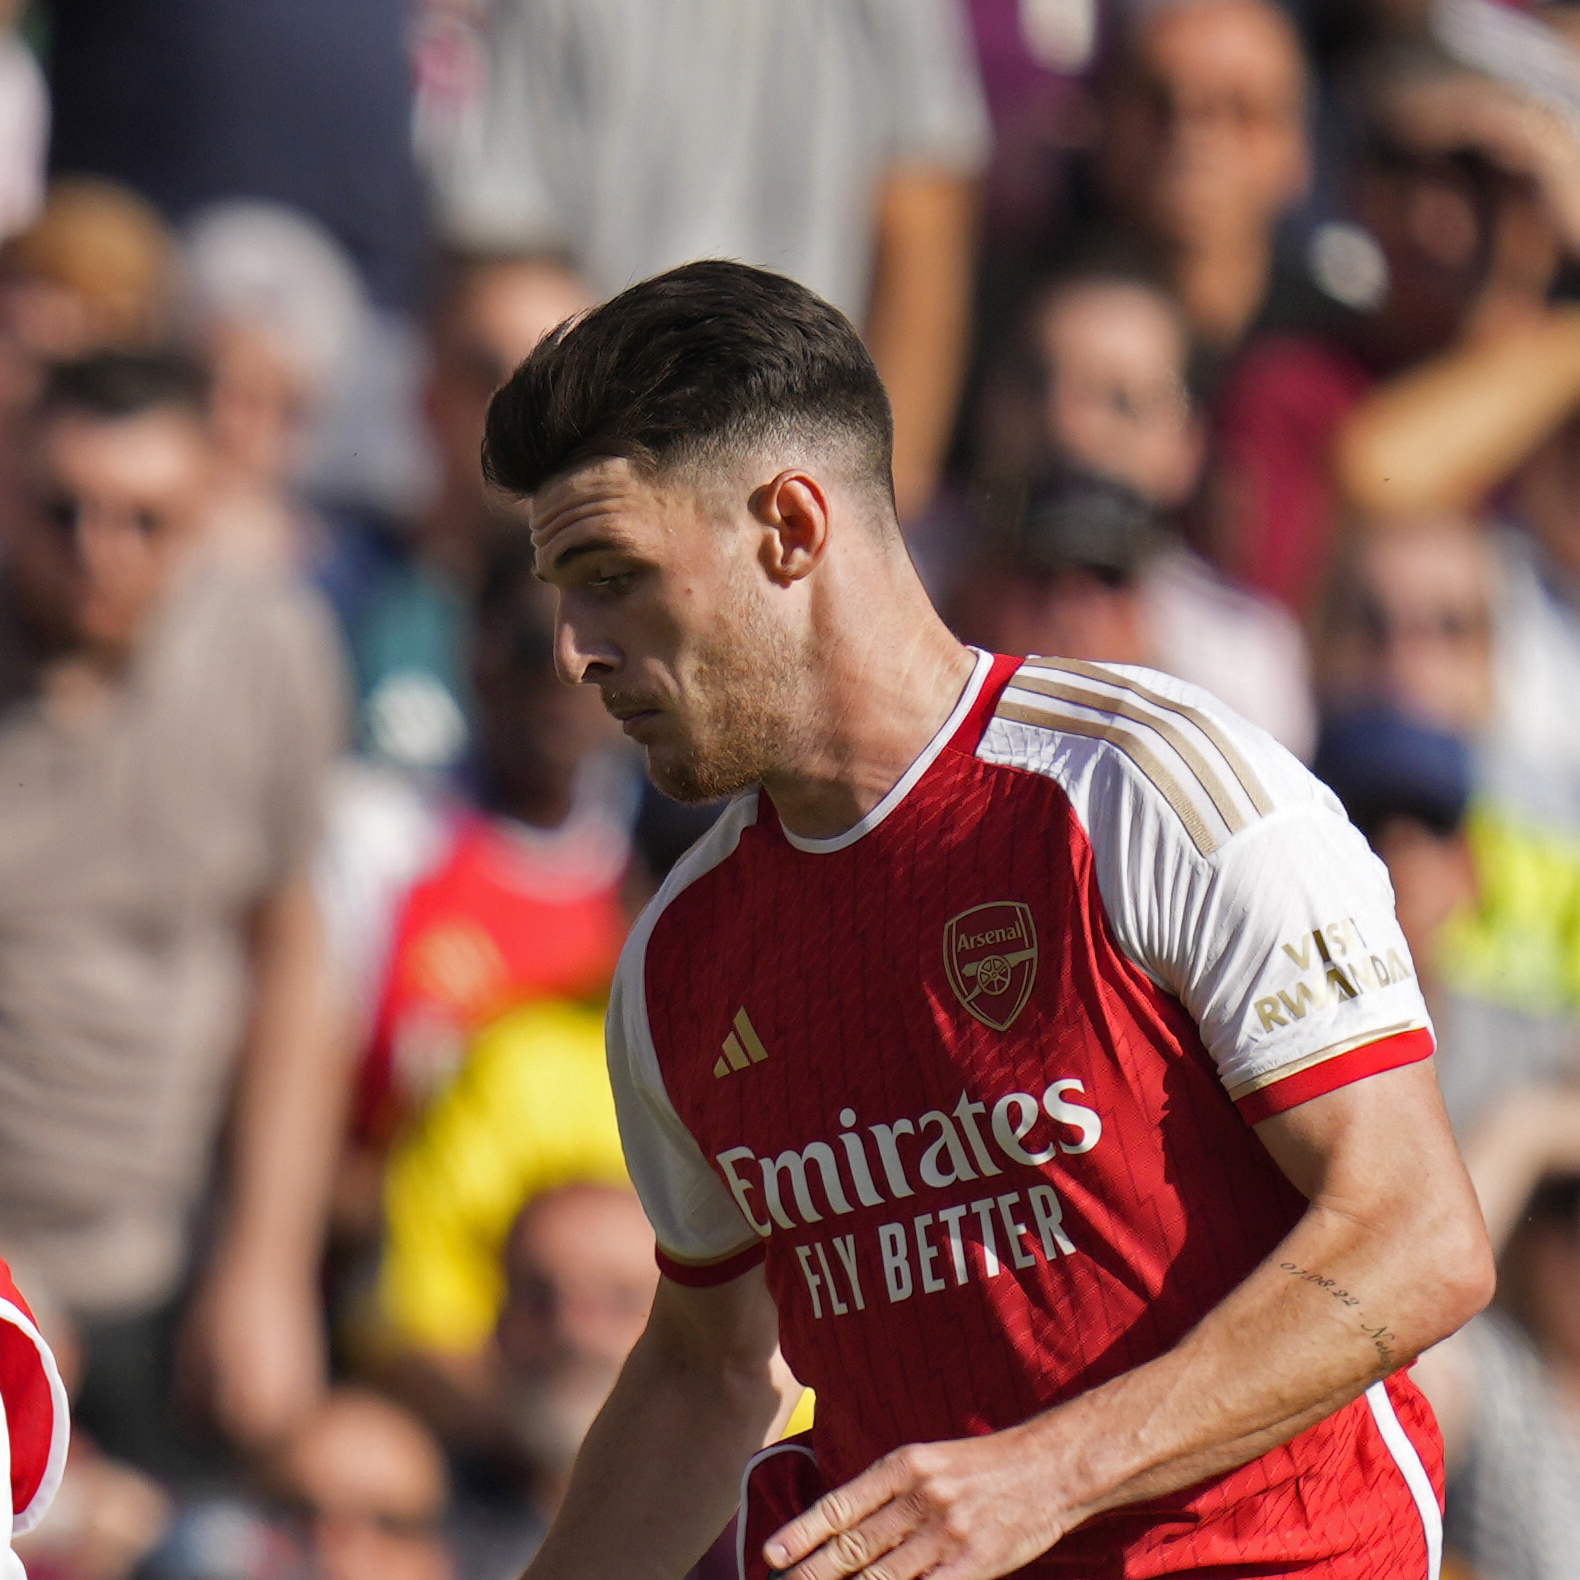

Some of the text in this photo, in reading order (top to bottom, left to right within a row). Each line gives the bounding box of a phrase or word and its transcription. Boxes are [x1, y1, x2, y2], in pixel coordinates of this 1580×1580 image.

[957, 921, 1023, 953] Arsenal
[1281, 917, 1367, 972] VISI
[1254, 946, 1413, 1034] RWANDA
[715, 1078, 1103, 1239] Emirates
[794, 1184, 1077, 1320] FLY BETTER
